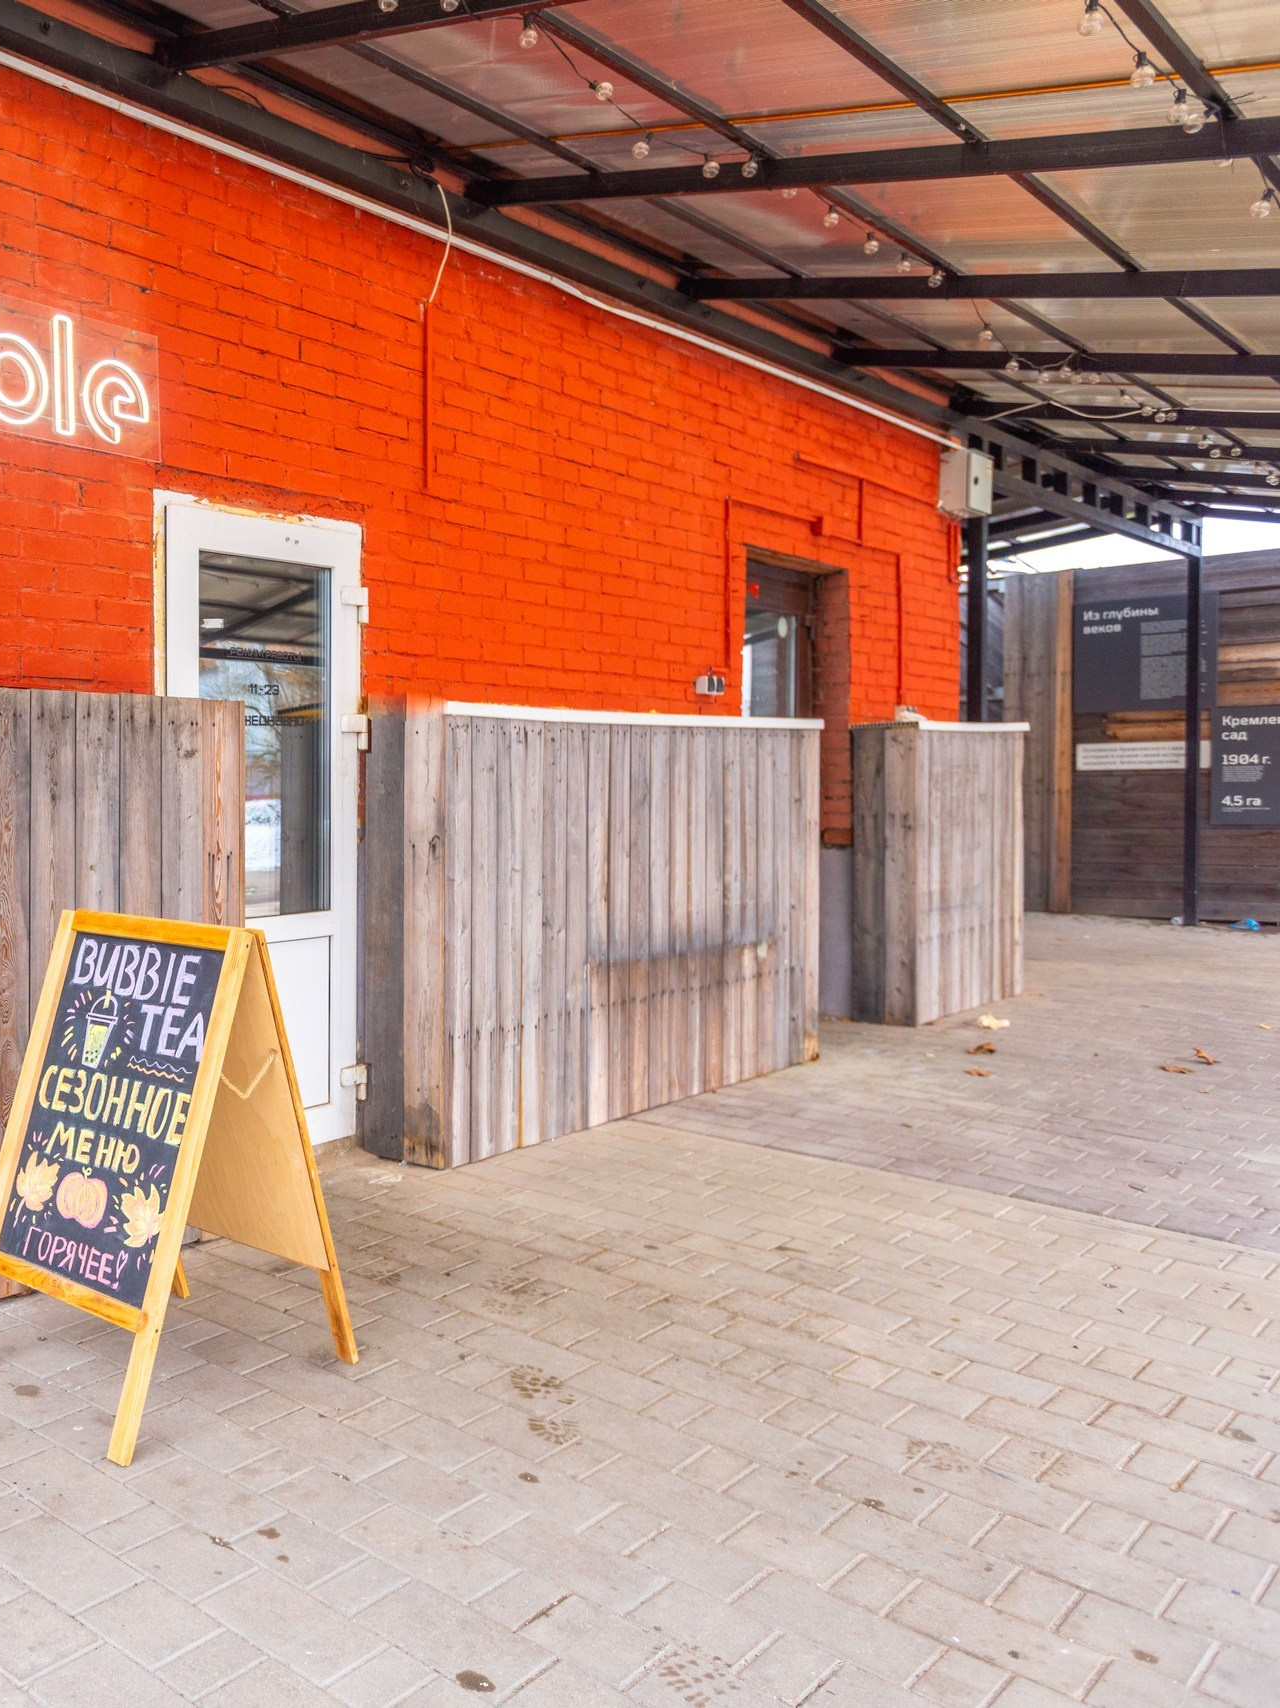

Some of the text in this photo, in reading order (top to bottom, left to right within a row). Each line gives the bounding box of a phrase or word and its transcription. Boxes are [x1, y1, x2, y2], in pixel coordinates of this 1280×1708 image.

[1083, 606, 1159, 621] Из глубины
[1083, 624, 1122, 635] веков
[230, 647, 302, 661] РЕЖИМ РАБОТЫ
[249, 684, 279, 695] 11-23
[1222, 715, 1280, 728] Кремле
[1221, 731, 1248, 741] сад
[1222, 754, 1271, 765] 1904 г.
[1221, 795, 1262, 807] 4,5 га
[139, 1004, 204, 1062] TEA
[38, 1064, 191, 1146] СЕЗОННОЕ
[45, 1121, 140, 1175] МЕНЮ
[22, 1225, 128, 1290] ГОРЯЧЕЕ!
